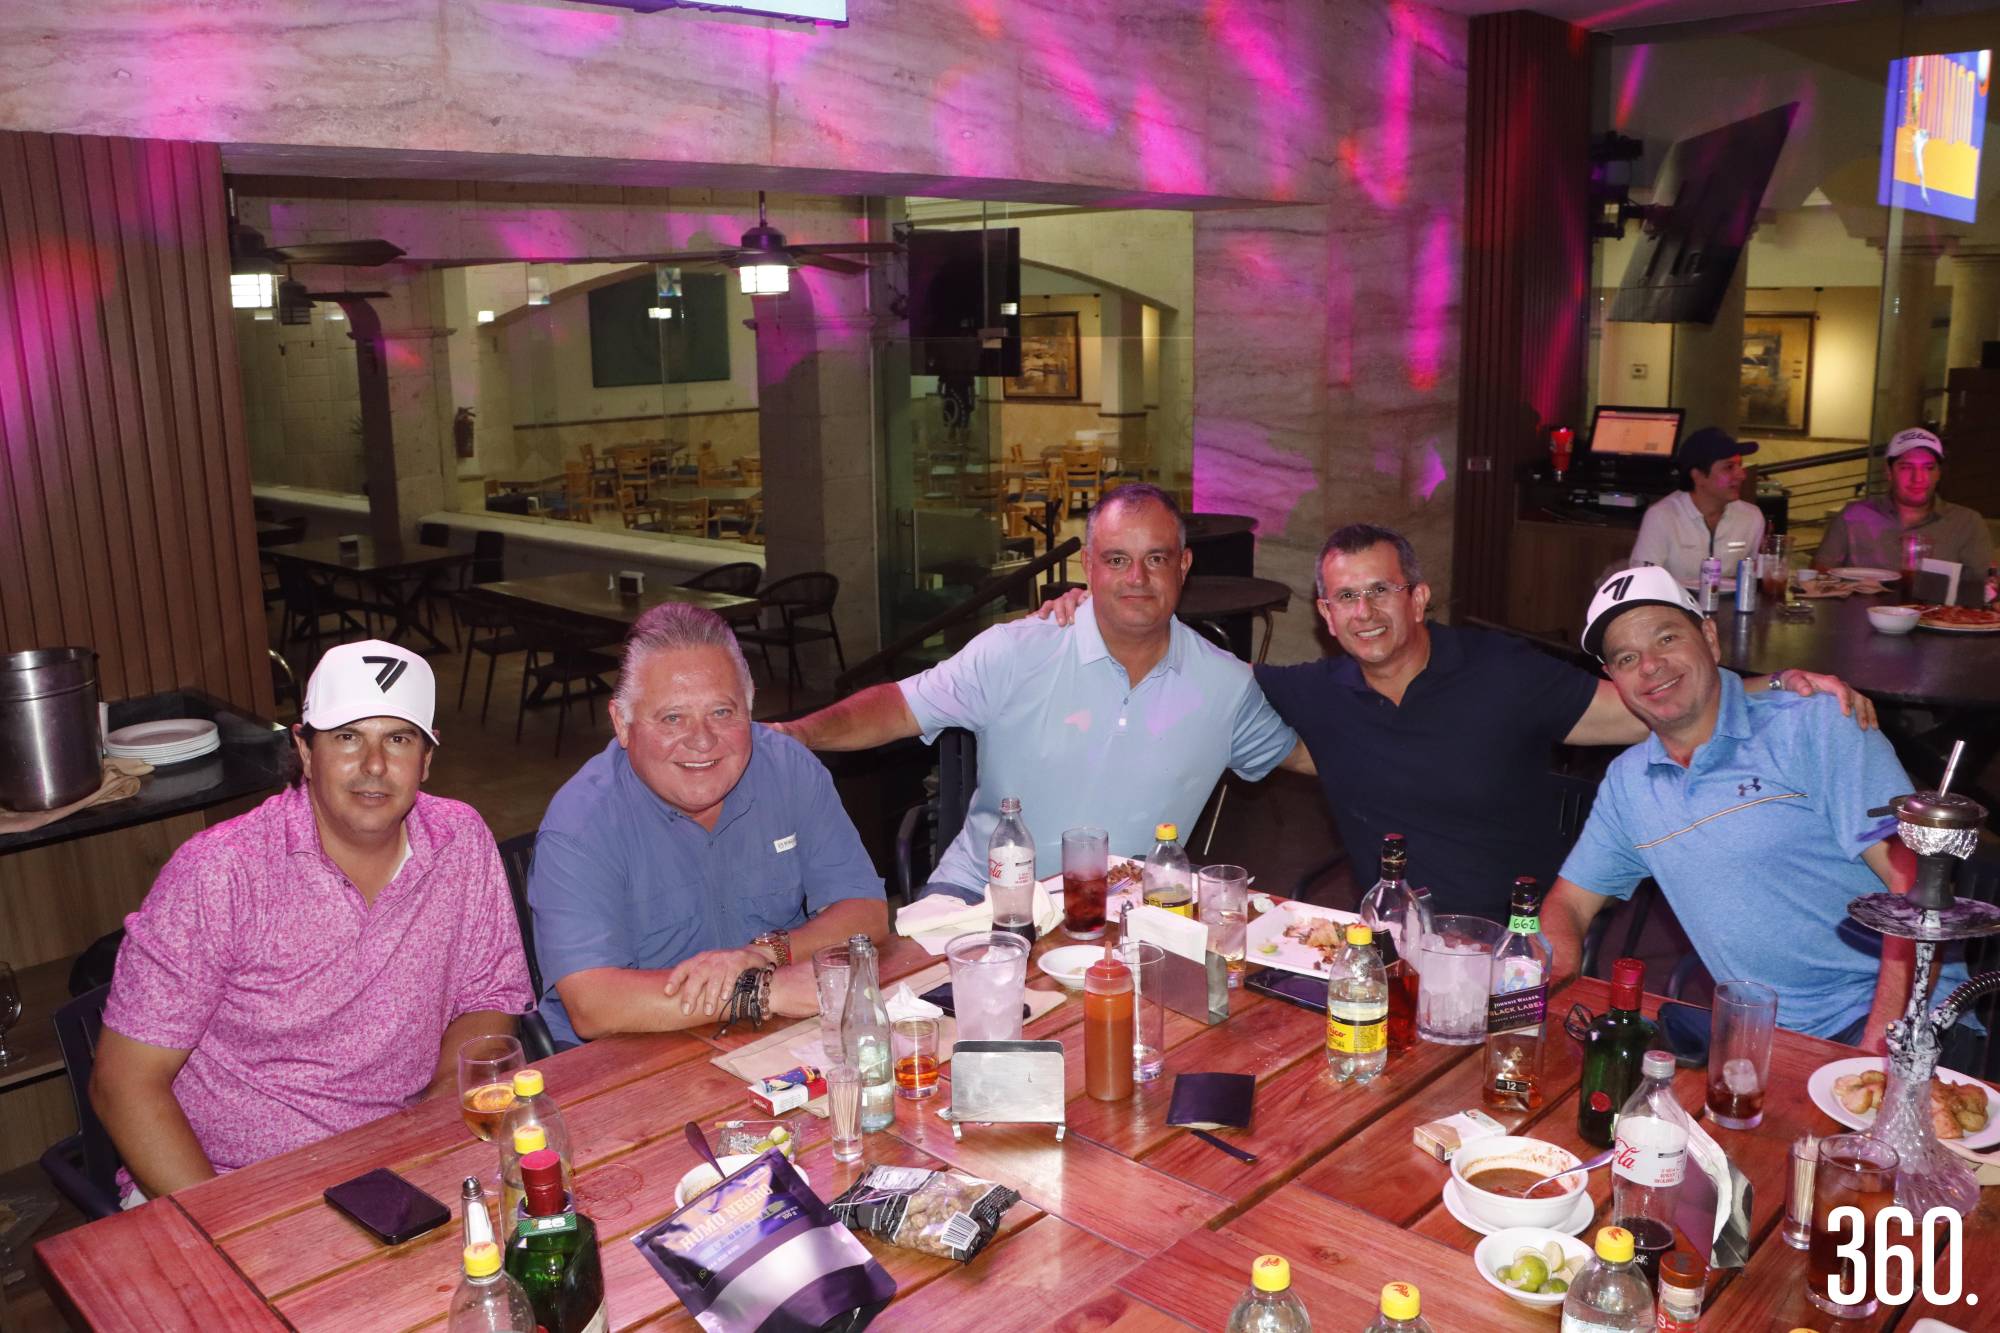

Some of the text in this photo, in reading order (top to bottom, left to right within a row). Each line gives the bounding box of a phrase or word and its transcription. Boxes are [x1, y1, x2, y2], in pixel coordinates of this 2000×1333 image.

[1513, 919, 1536, 930] 662
[1488, 1006, 1517, 1017] BLACK
[1517, 1001, 1544, 1011] LABEL
[1506, 1081, 1517, 1091] 12
[680, 1183, 774, 1251] HUMO NEGRO
